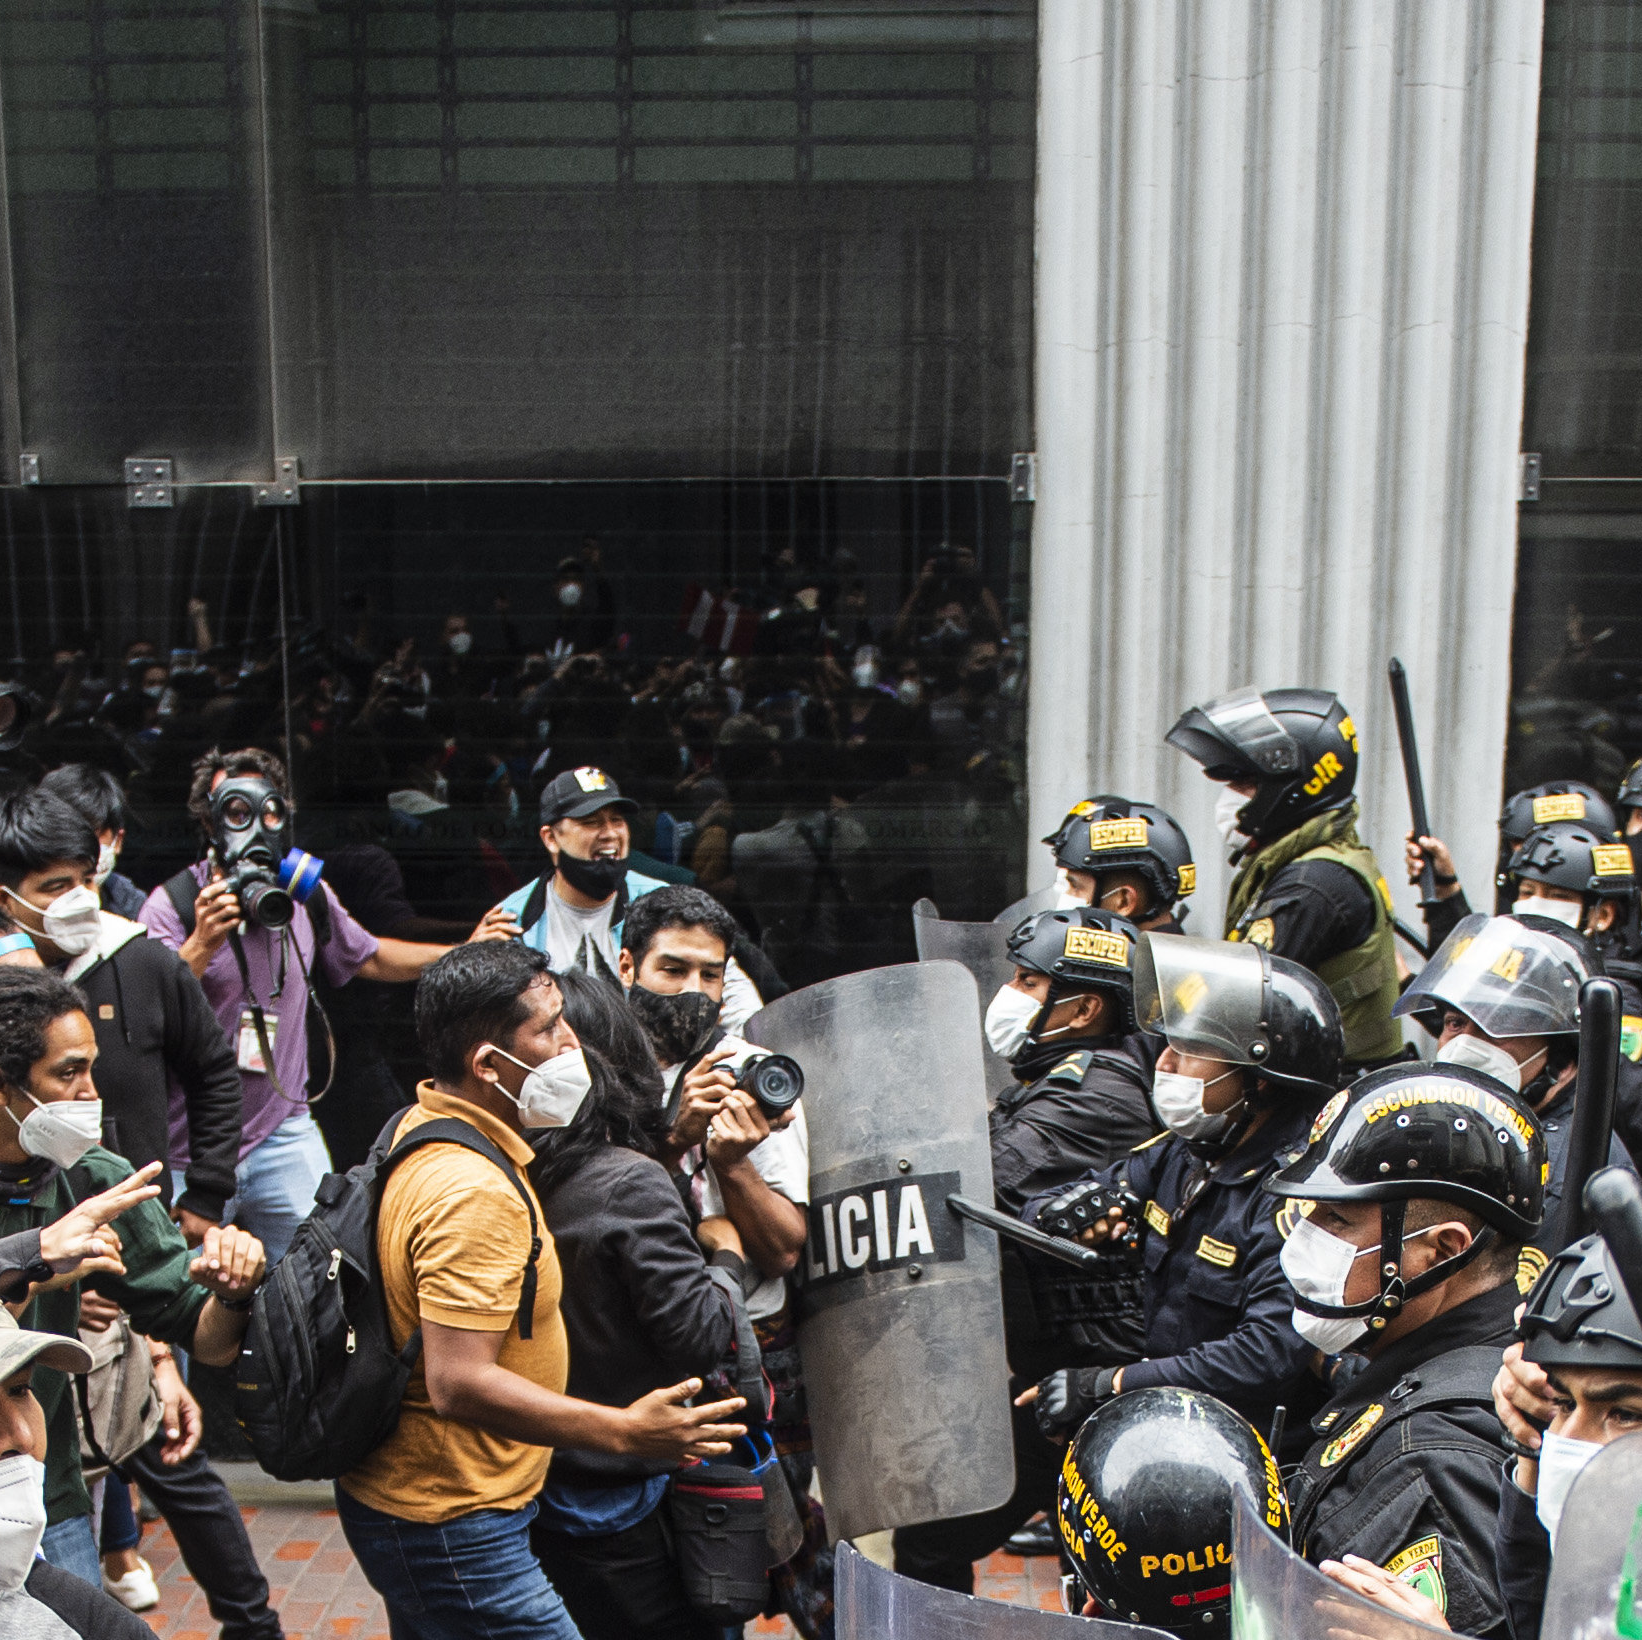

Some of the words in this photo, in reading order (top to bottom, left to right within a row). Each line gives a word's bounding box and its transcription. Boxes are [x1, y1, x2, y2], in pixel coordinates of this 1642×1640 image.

[1092, 823, 1145, 846] ESCOPER
[1070, 931, 1125, 960] ESCOPER
[1361, 1085, 1481, 1126] ESCUADRON
[1484, 1091, 1537, 1147] VERDE
[1080, 1492, 1128, 1563] VERDE
[1408, 1541, 1436, 1560] VERDE
